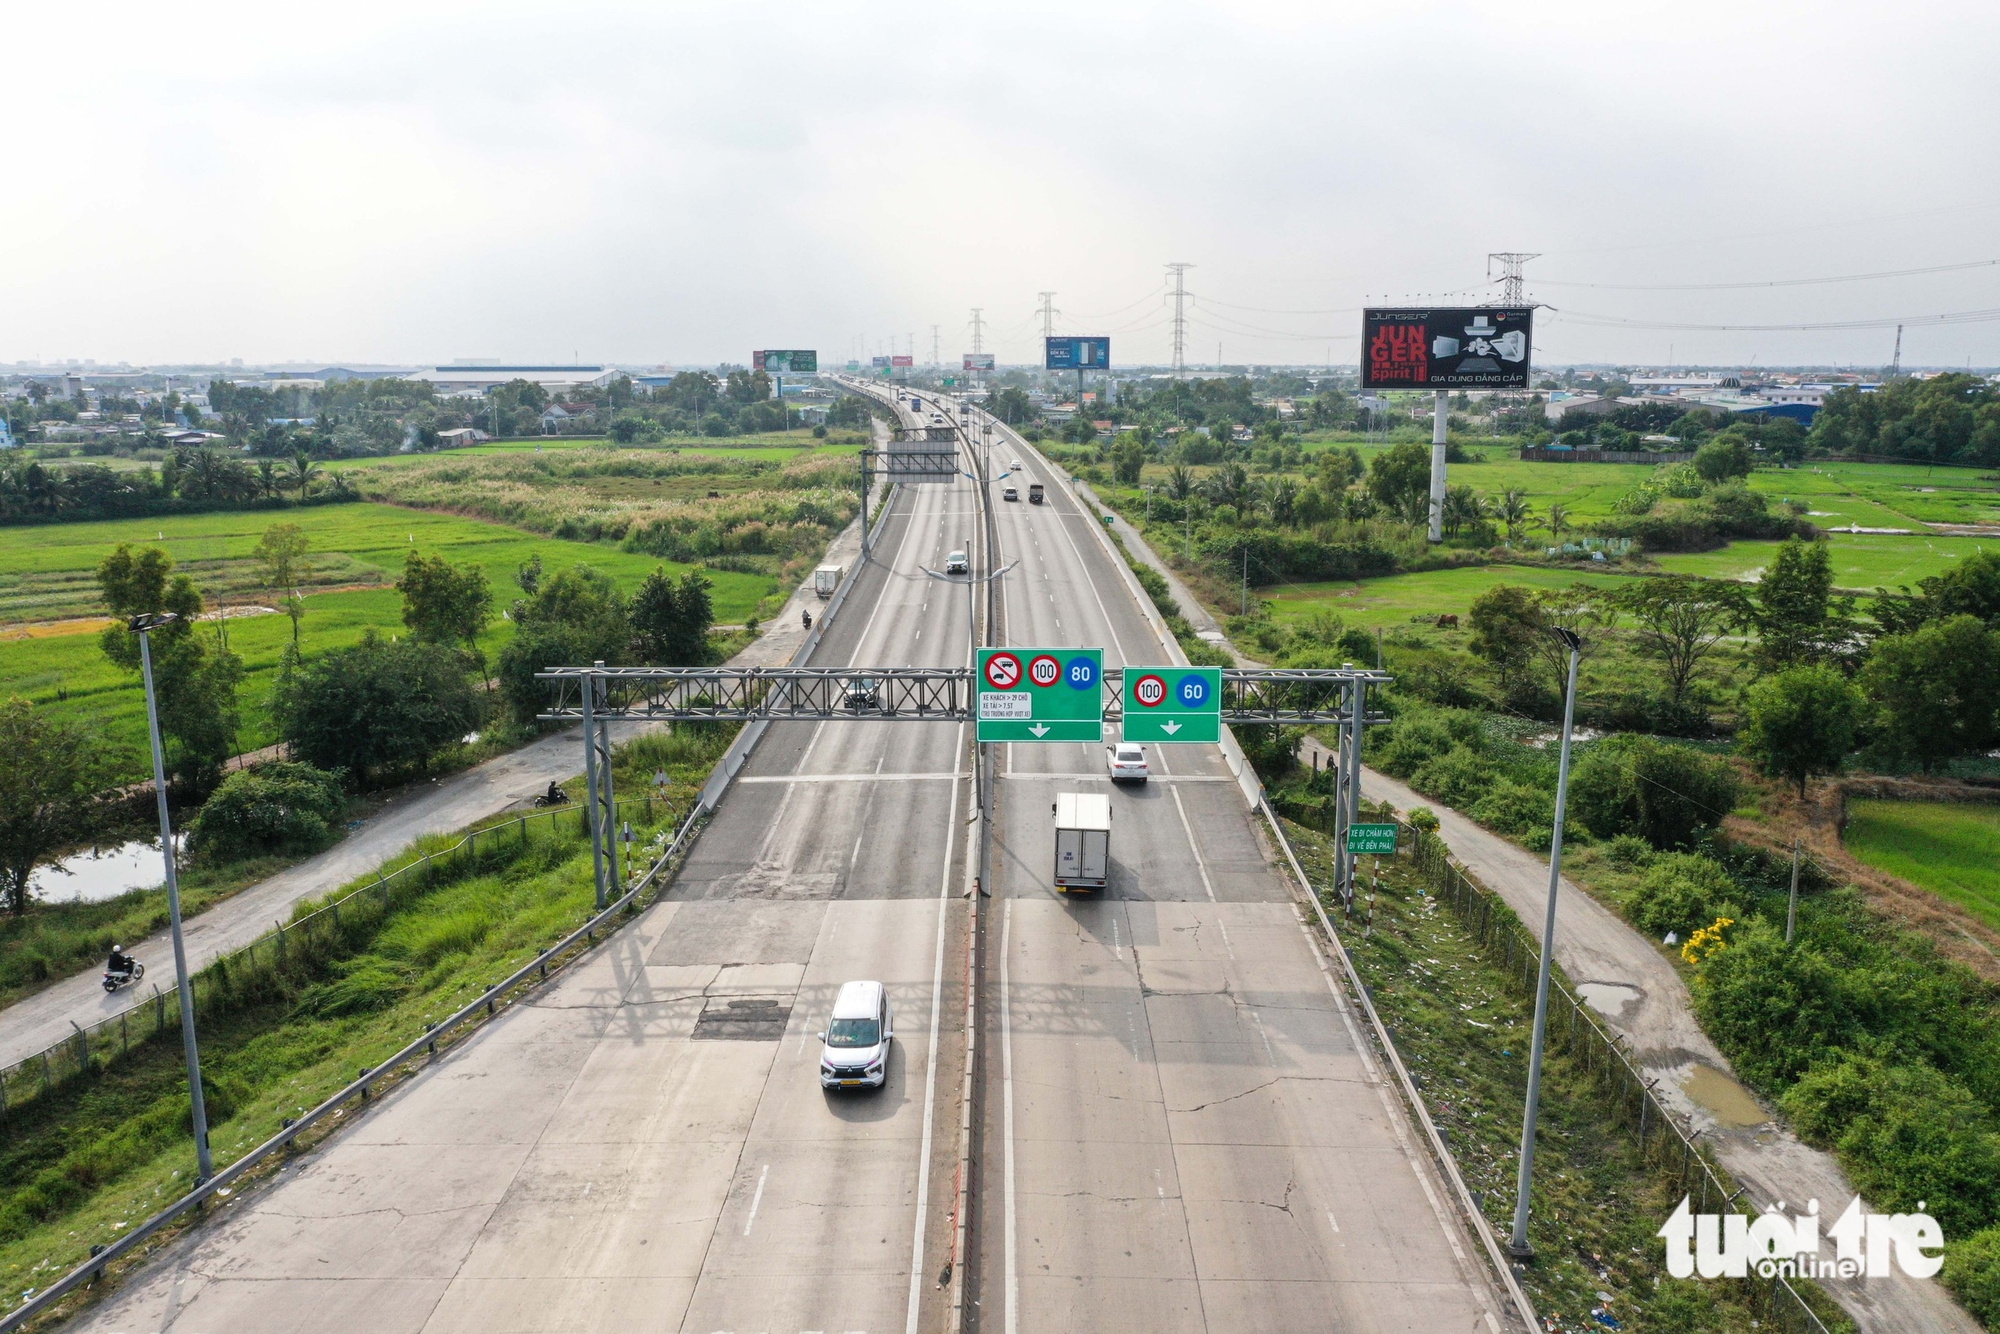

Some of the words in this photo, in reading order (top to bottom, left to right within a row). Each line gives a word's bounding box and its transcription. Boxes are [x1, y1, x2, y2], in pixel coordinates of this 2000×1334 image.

[1371, 325, 1426, 344] JUN
[1370, 343, 1427, 362] GER
[1372, 367, 1411, 382] spirit
[1035, 664, 1054, 679] 100
[1071, 666, 1090, 682] 80
[990, 693, 1006, 701] KHÁCH
[1141, 684, 1160, 699] 100
[1184, 684, 1203, 699] 60
[1351, 829, 1358, 837] XE
[1359, 829, 1365, 837] ĐI
[1365, 828, 1382, 838] CHẬM
[1349, 842, 1355, 850] ĐI
